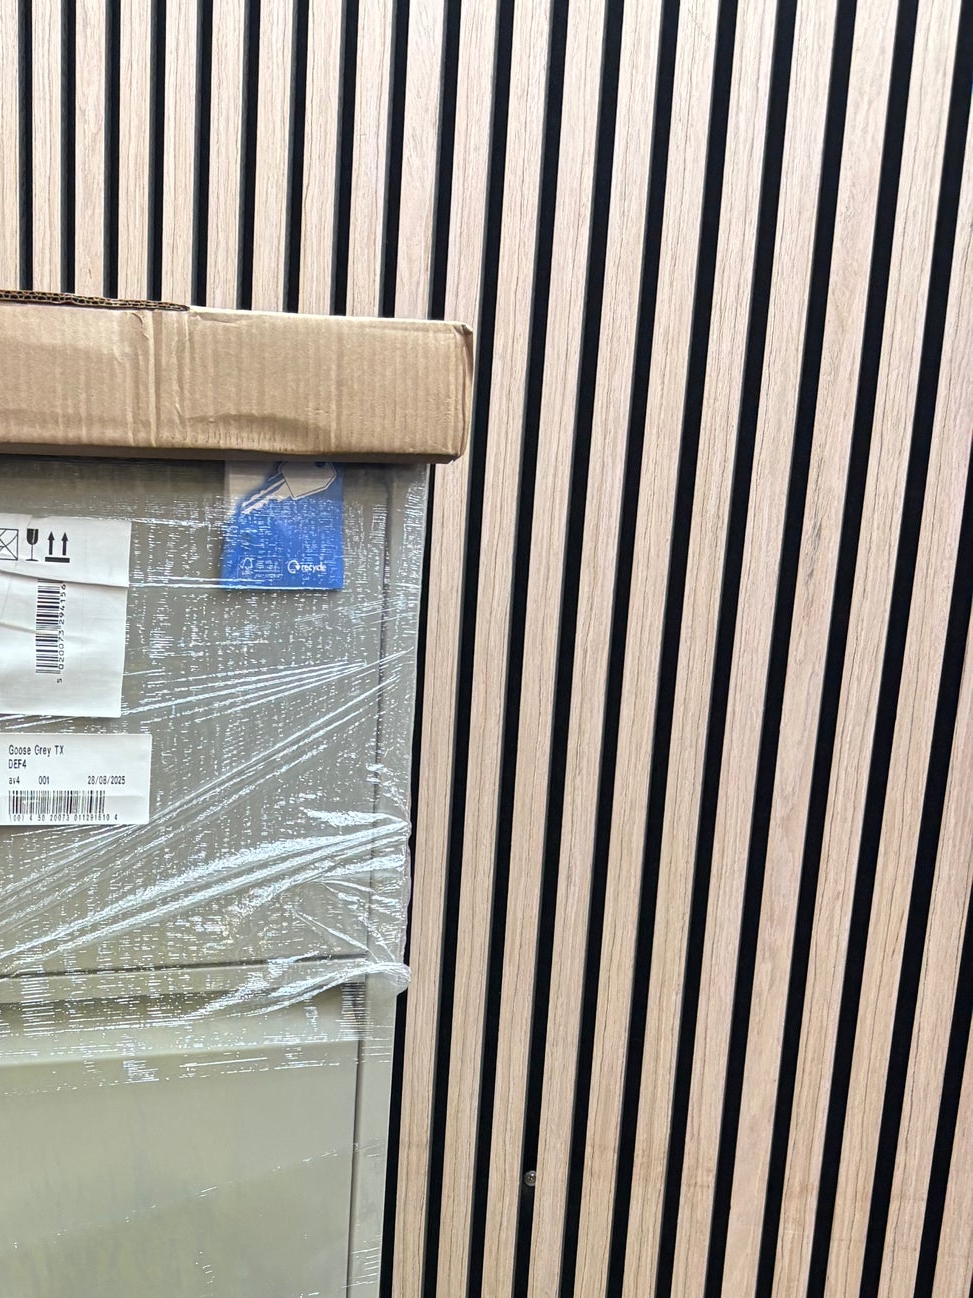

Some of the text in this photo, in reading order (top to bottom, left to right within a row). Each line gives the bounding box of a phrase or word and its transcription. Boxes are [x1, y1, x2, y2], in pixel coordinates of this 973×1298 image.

[300, 562, 326, 573] recycle
[58, 584, 66, 625] 294156
[8, 744, 65, 758] Goose Grey TX
[8, 759, 27, 769] DEF4
[8, 774, 127, 786] av4 001 28/08/2025
